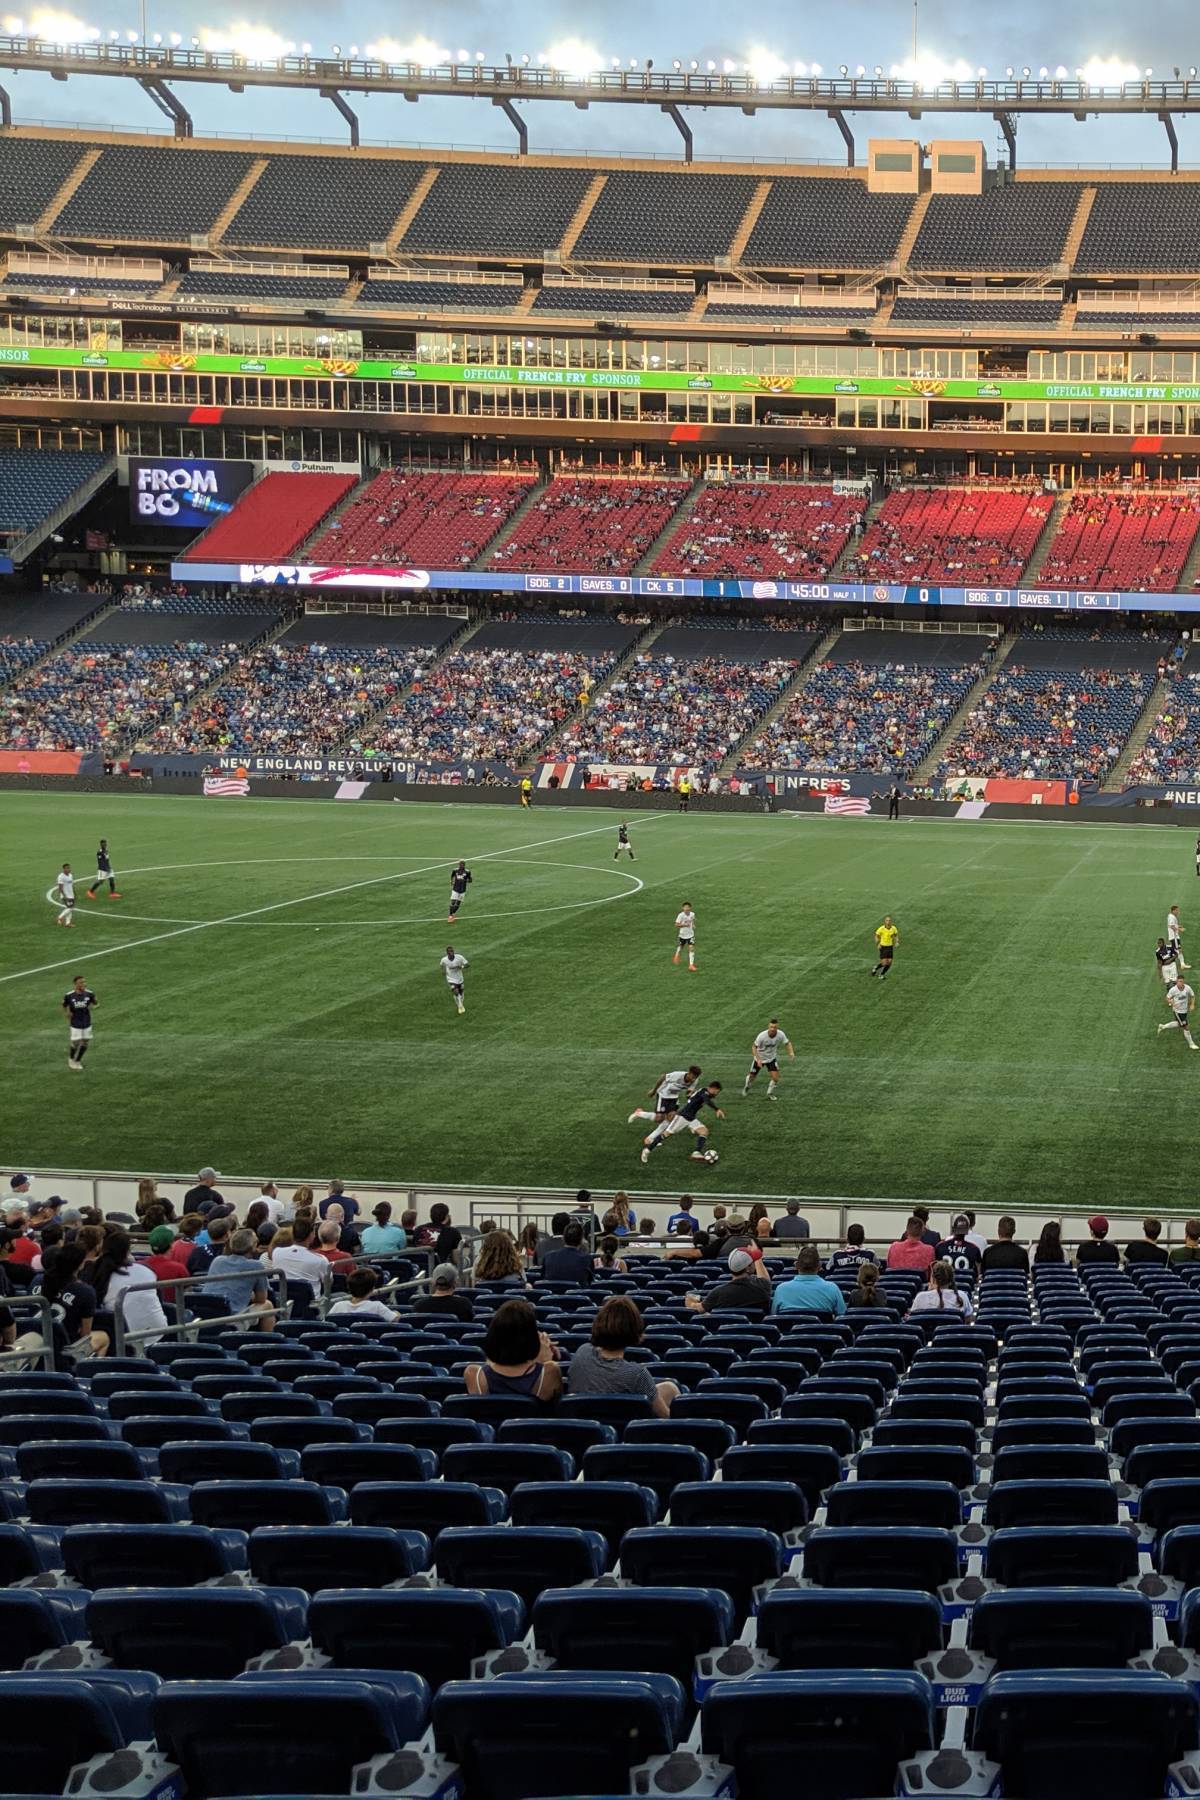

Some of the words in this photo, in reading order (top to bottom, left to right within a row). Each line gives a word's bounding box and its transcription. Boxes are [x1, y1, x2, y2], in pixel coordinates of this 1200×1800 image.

[463, 369, 512, 380] OFFICIAL
[518, 370, 562, 382] FRENCH
[566, 372, 587, 383] FRY
[592, 373, 641, 385] SPONSOR
[1046, 386, 1094, 397] OFFICIAL
[1100, 387, 1143, 398] FRENCH
[1146, 387, 1166, 398] FRY
[302, 463, 334, 471] Putnam
[138, 468, 218, 493] FROM
[530, 578, 551, 588] SOG:
[558, 579, 564, 589] 2
[582, 580, 614, 590] SAVES:
[620, 580, 627, 590] 0
[647, 582, 661, 591] CK:
[667, 582, 674, 591] 5
[719, 582, 724, 595] 1
[791, 584, 829, 598] 45:00
[833, 591, 849, 599] HALF
[920, 588, 929, 602] 0
[969, 592, 989, 602] SOG:
[995, 592, 1001, 602] 0
[1020, 594, 1051, 604] SAVES:
[1083, 595, 1098, 605] CK:
[220, 757, 252, 769] NEW
[256, 758, 322, 771] ENGLAND
[945, 1687, 966, 1695] BUD
[940, 1694, 970, 1702] LIGHT
